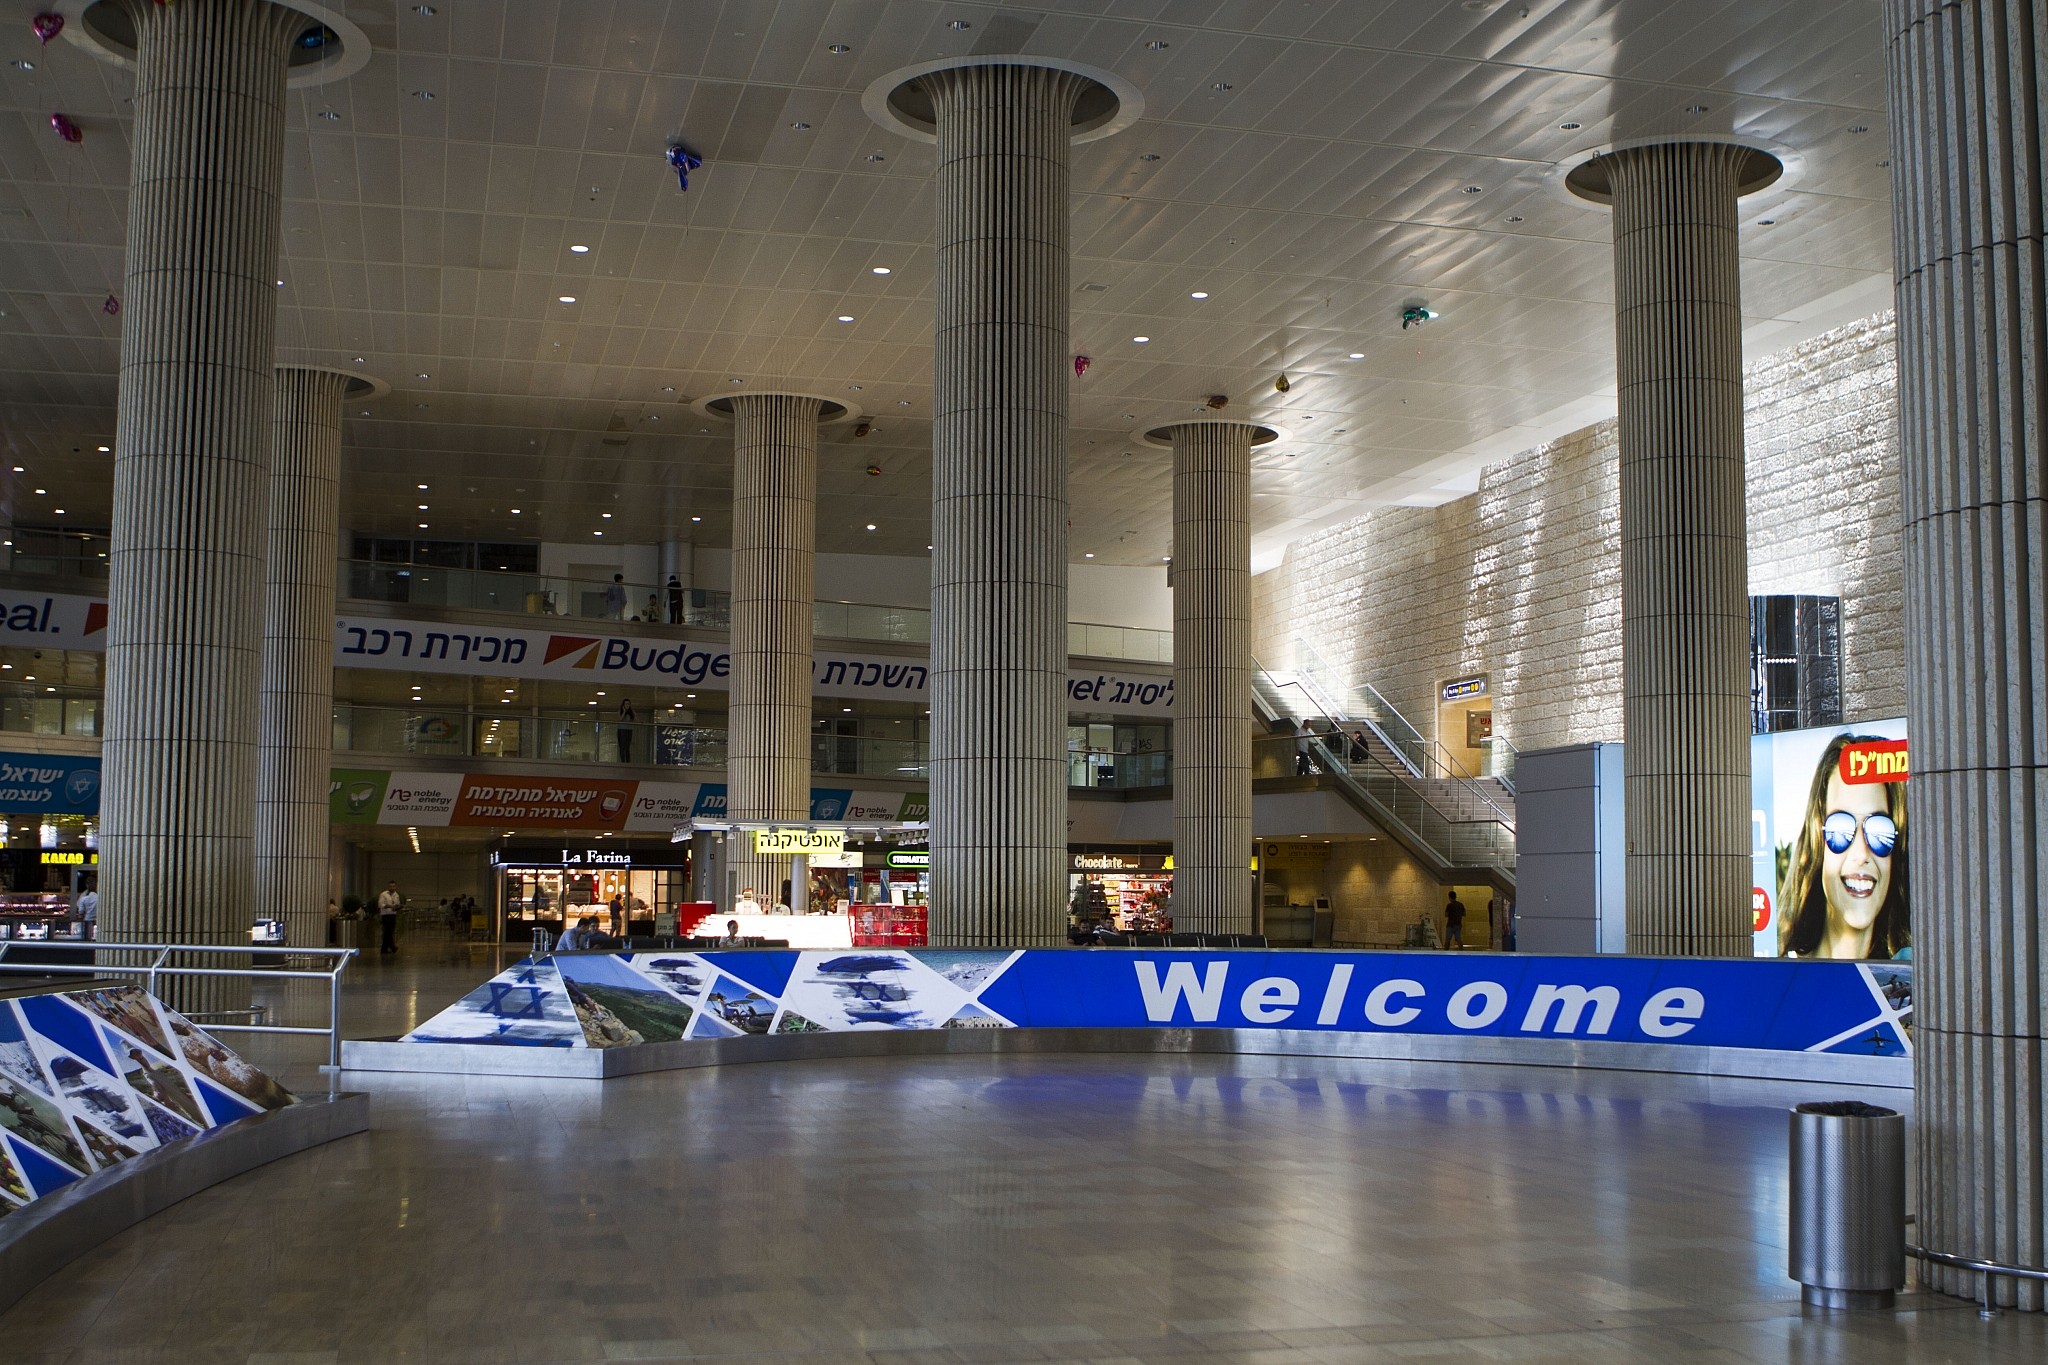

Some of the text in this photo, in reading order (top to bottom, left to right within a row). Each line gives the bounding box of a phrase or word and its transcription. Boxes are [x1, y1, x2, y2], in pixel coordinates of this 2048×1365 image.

[342, 627, 528, 664] מכירת רכב
[820, 661, 928, 690] השכרת
[0, 763, 64, 784] ישראל
[413, 790, 442, 798] noble
[418, 796, 452, 805] energy
[465, 786, 598, 804] ישראל מתקדמת
[656, 798, 682, 806] noble
[660, 804, 690, 813] energy
[469, 805, 583, 819] לאנרגיה חסכונית
[866, 806, 887, 814] noble
[869, 812, 894, 820] energy
[760, 834, 841, 850] אופטיקנה
[41, 852, 84, 865] KAKAO
[562, 849, 632, 863] La Farina
[1075, 855, 1123, 869] Chocolate
[1133, 960, 1706, 1038] Welcome
